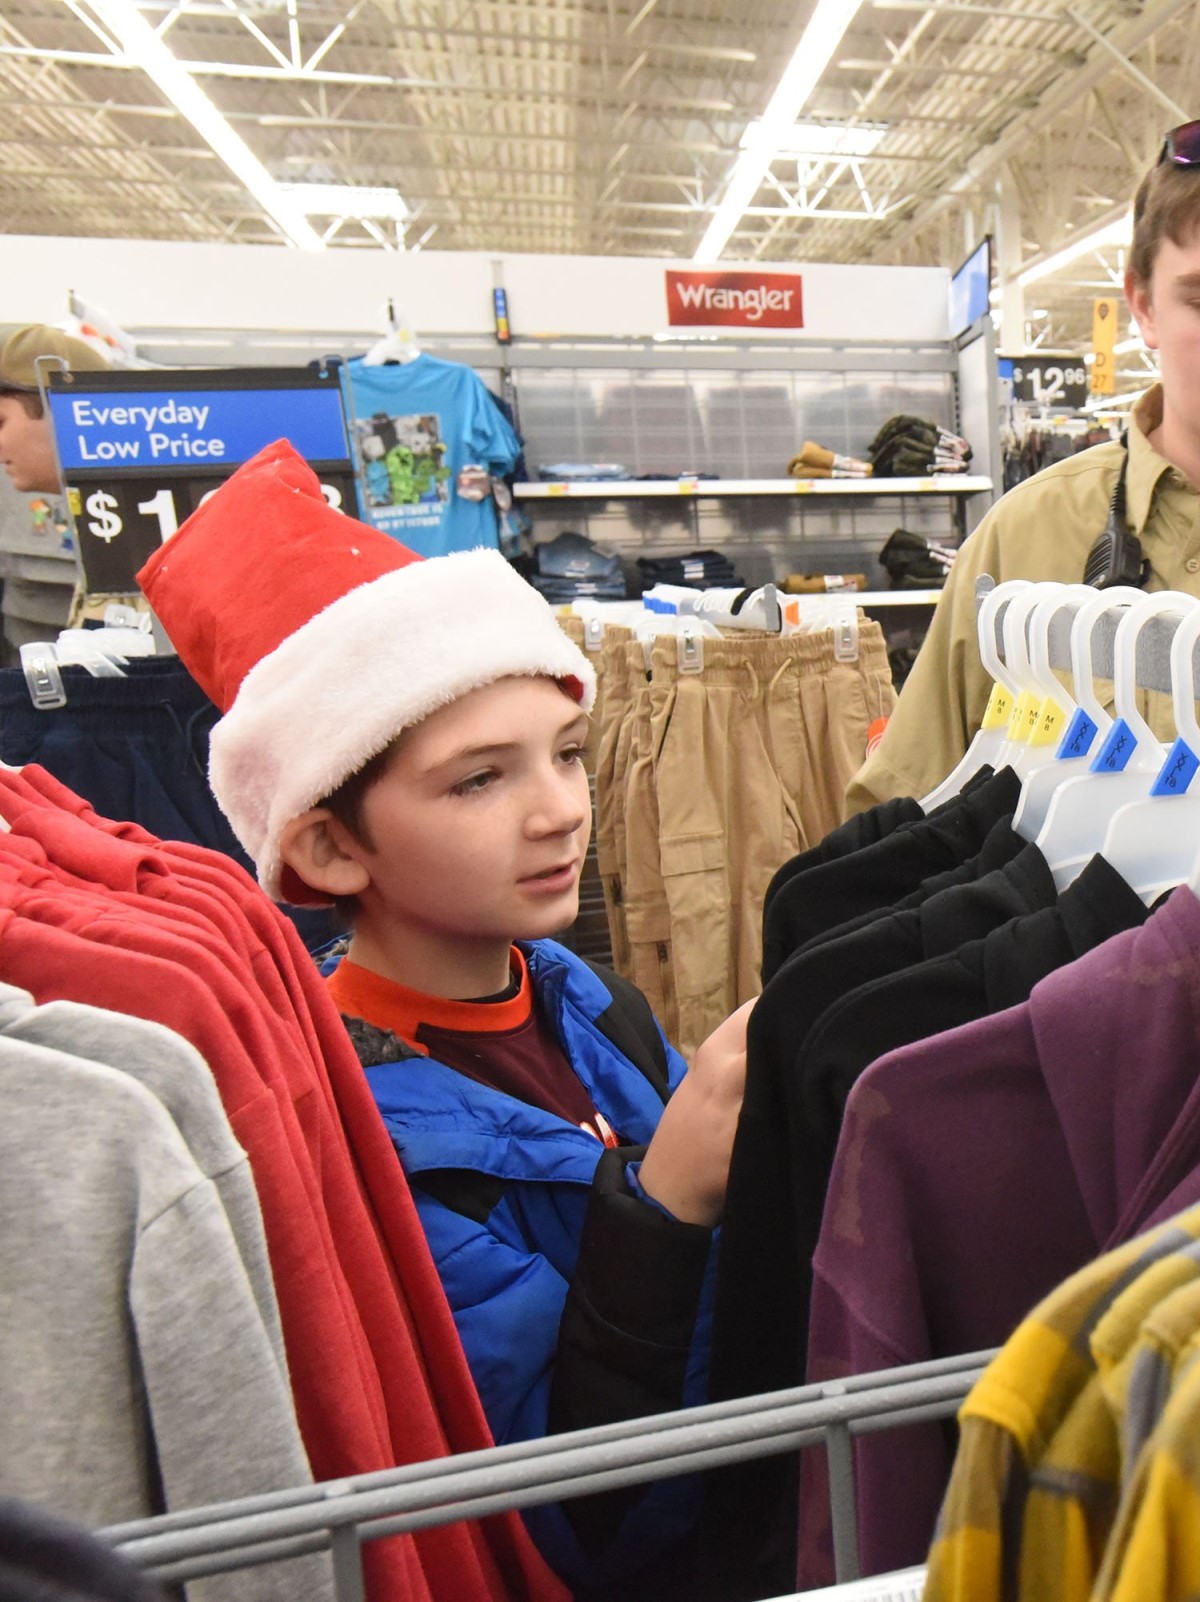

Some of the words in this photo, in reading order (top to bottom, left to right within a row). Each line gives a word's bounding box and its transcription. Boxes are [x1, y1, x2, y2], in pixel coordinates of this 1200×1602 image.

[676, 282, 794, 320] Wrangler
[72, 399, 210, 431] Everyday
[78, 435, 140, 460] Low
[150, 432, 225, 458] Price
[997, 699, 1006, 707] M
[1029, 710, 1037, 718] M
[1045, 714, 1054, 724] M
[1070, 742, 1080, 753] 18
[1106, 756, 1116, 768] 18
[1165, 776, 1177, 788] 18
